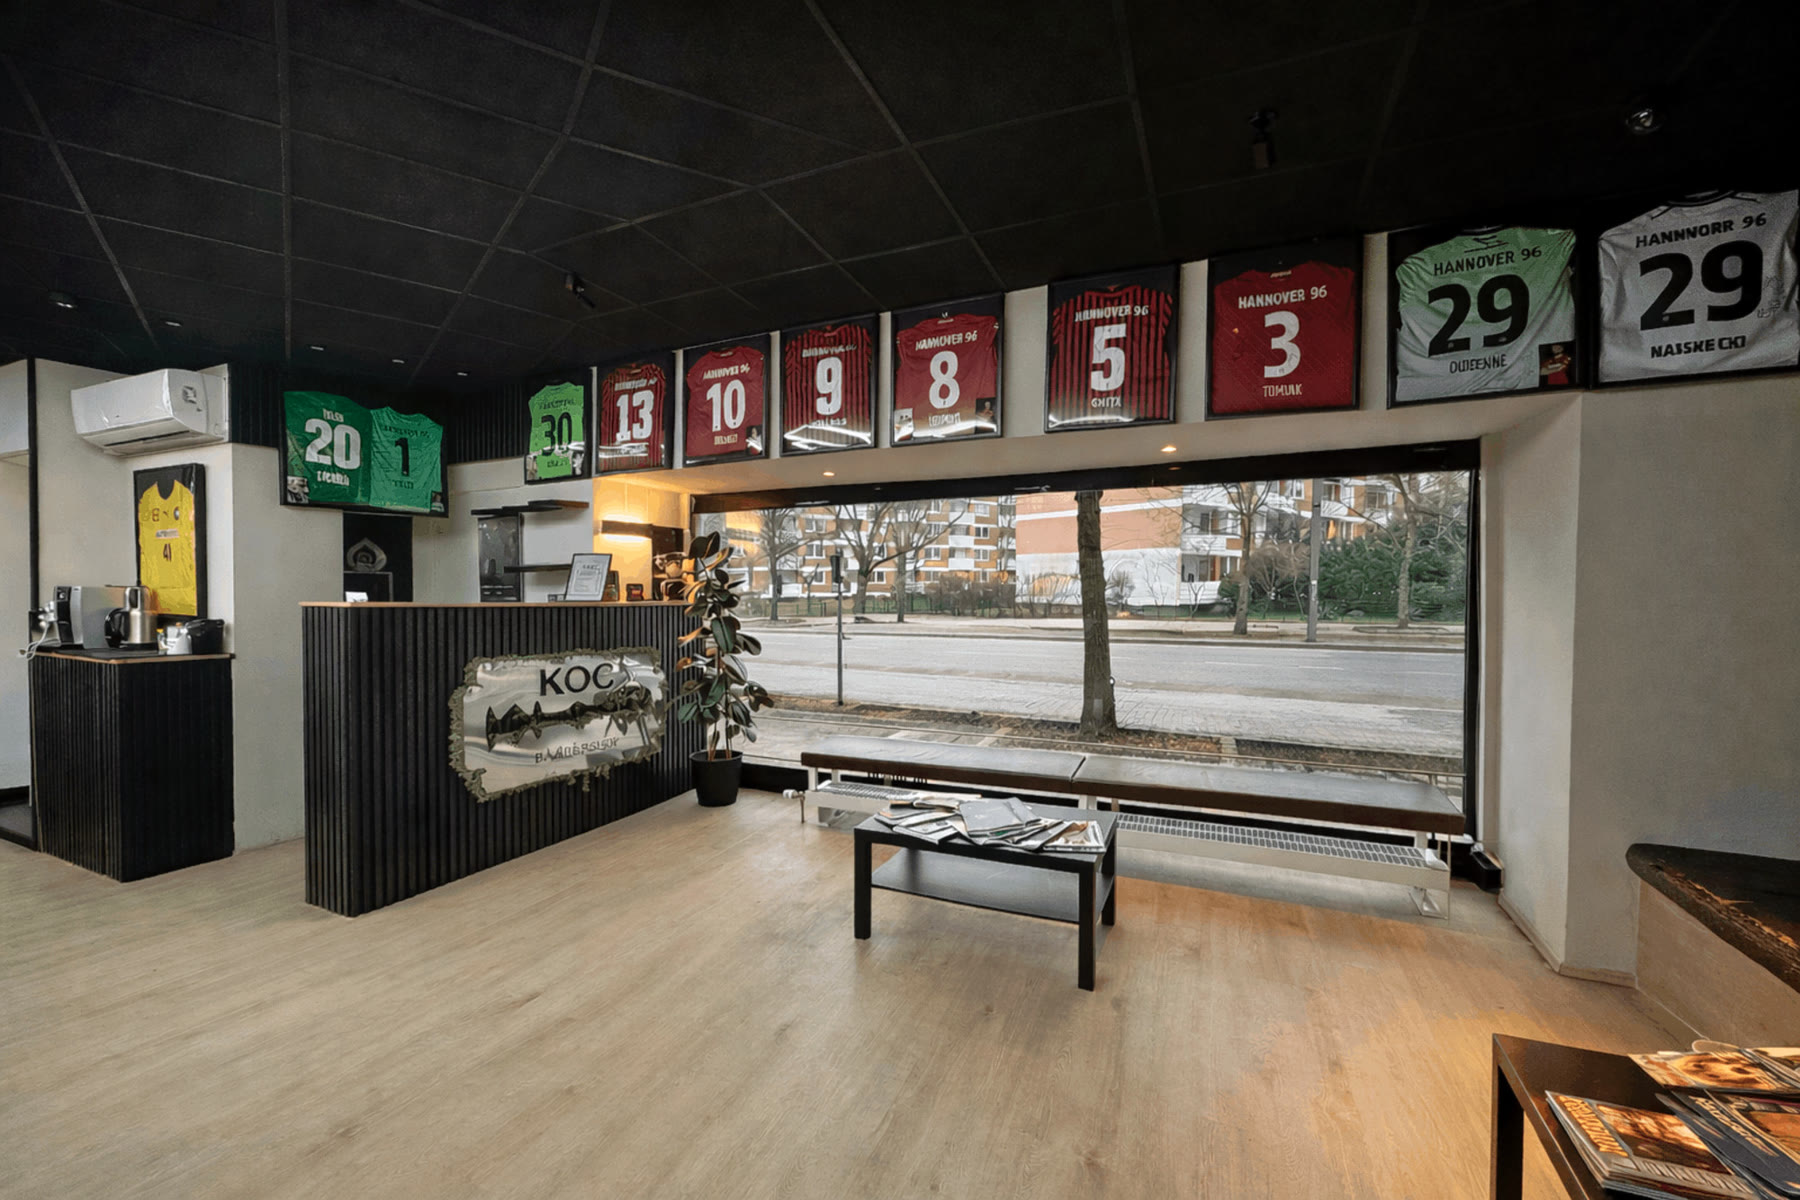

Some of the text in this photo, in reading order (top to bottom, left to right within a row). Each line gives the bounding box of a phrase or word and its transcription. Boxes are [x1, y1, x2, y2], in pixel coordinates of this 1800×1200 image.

[1742, 213, 1767, 229] 96
[1434, 246, 1542, 276] HANNOVER 96
[1639, 240, 1763, 331] 29
[1133, 305, 1150, 316] 96
[1238, 285, 1328, 309] HANNOVER 96
[1428, 274, 1530, 358] 29
[964, 330, 978, 343] 96
[1091, 323, 1127, 391] 5
[1263, 310, 1301, 378] 3
[706, 379, 746, 432] 10
[815, 356, 843, 416] 9
[929, 350, 960, 409] 8
[541, 411, 572, 456] 30
[616, 389, 654, 442] 13
[304, 418, 361, 470] 20
[394, 437, 410, 477] 1
[539, 662, 614, 697] KOC
